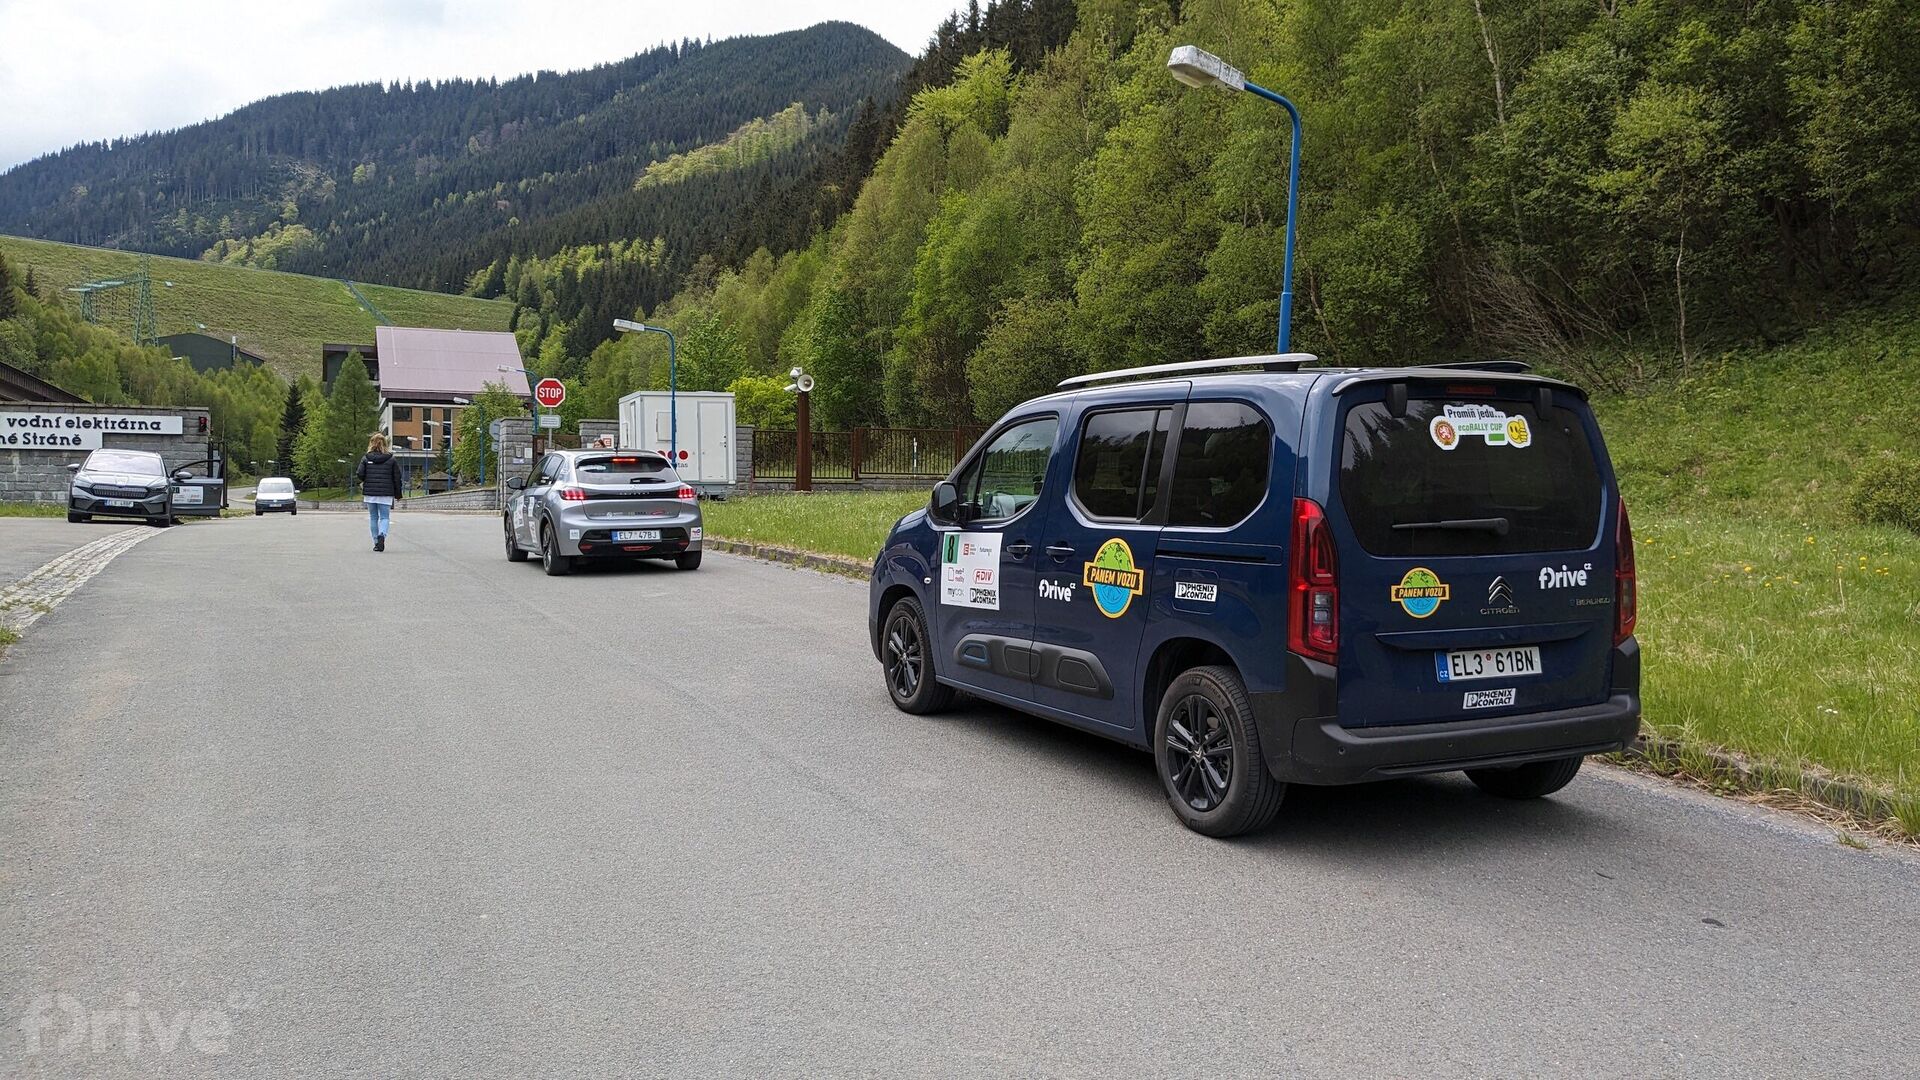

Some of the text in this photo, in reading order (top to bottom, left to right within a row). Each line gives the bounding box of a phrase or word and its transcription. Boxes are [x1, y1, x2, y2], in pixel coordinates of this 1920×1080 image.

[539, 387, 562, 399] STOP
[7, 415, 162, 431] vodní elektrárna
[1458, 422, 1503, 432] ecoRALLY CUP
[22, 432, 82, 446] Stráně
[619, 531, 657, 540] EL7 47BJ
[947, 534, 955, 563] 8
[975, 570, 992, 581] ADIV
[1090, 568, 1137, 588] PANEM VOZU
[1186, 591, 1215, 600] CONTACT
[1398, 587, 1444, 598] PANEM VOZU
[976, 596, 996, 605] CONTACT
[1451, 649, 1535, 677] EL3 61BN
[1440, 670, 1449, 678] CZ
[1477, 697, 1511, 707] CONTACT
